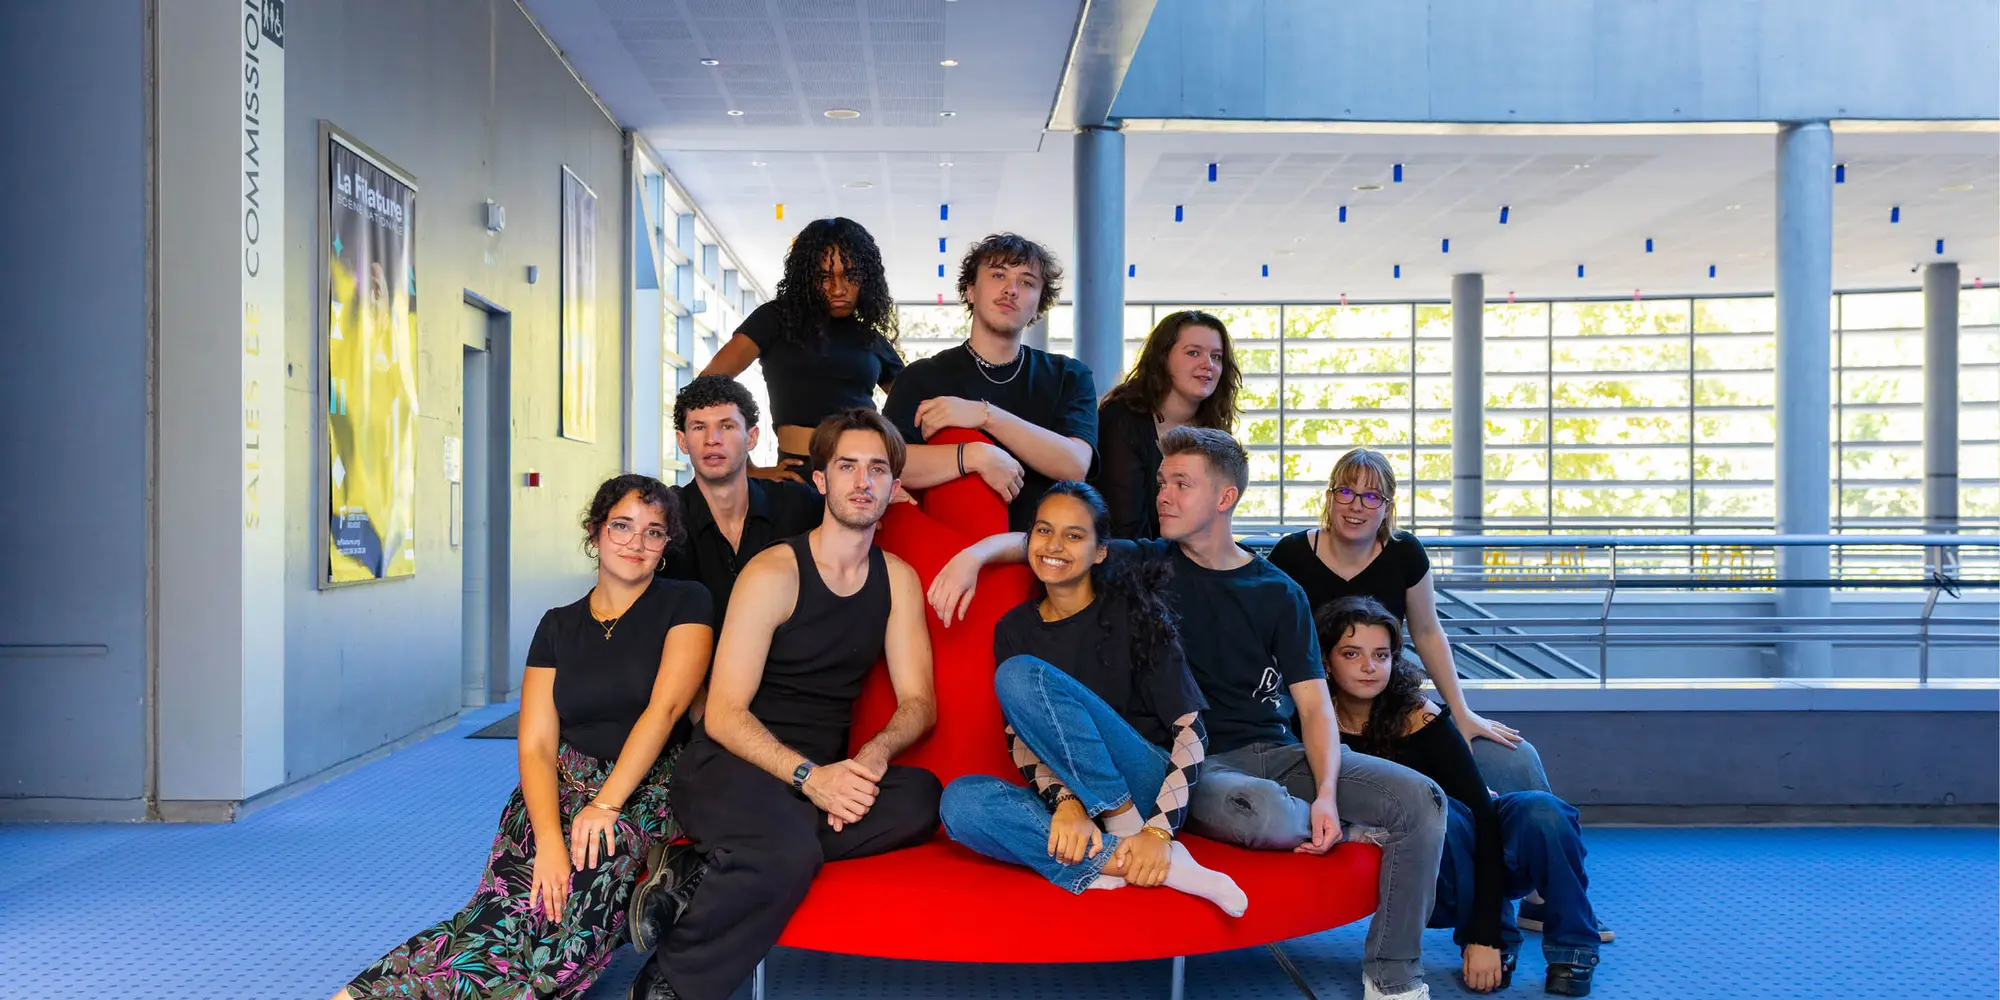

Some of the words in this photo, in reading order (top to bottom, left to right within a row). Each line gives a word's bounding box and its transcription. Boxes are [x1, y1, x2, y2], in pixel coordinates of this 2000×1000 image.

[337, 162, 352, 196] La
[355, 172, 403, 223] Filature
[245, 301, 260, 356] DE
[245, 380, 260, 530] SALLES
